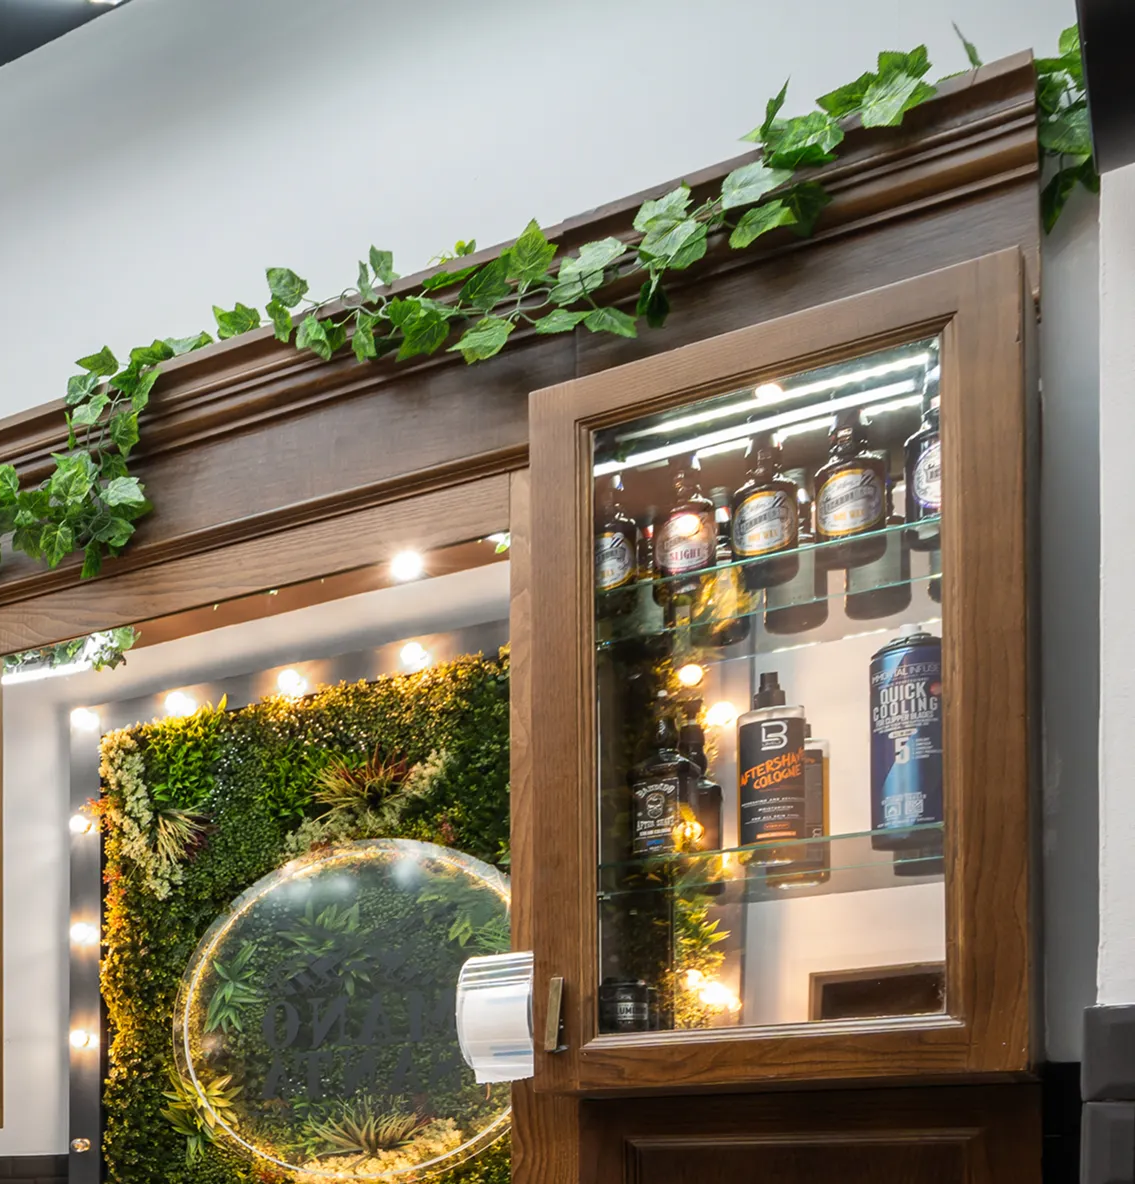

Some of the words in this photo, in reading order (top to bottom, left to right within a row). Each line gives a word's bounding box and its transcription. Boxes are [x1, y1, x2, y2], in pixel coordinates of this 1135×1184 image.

[880, 682, 927, 705] QUICK
[872, 696, 938, 722] COOLING
[894, 737, 910, 764] 5
[740, 746, 805, 787] AFTERSHAVE
[752, 764, 802, 790] COLOGNE
